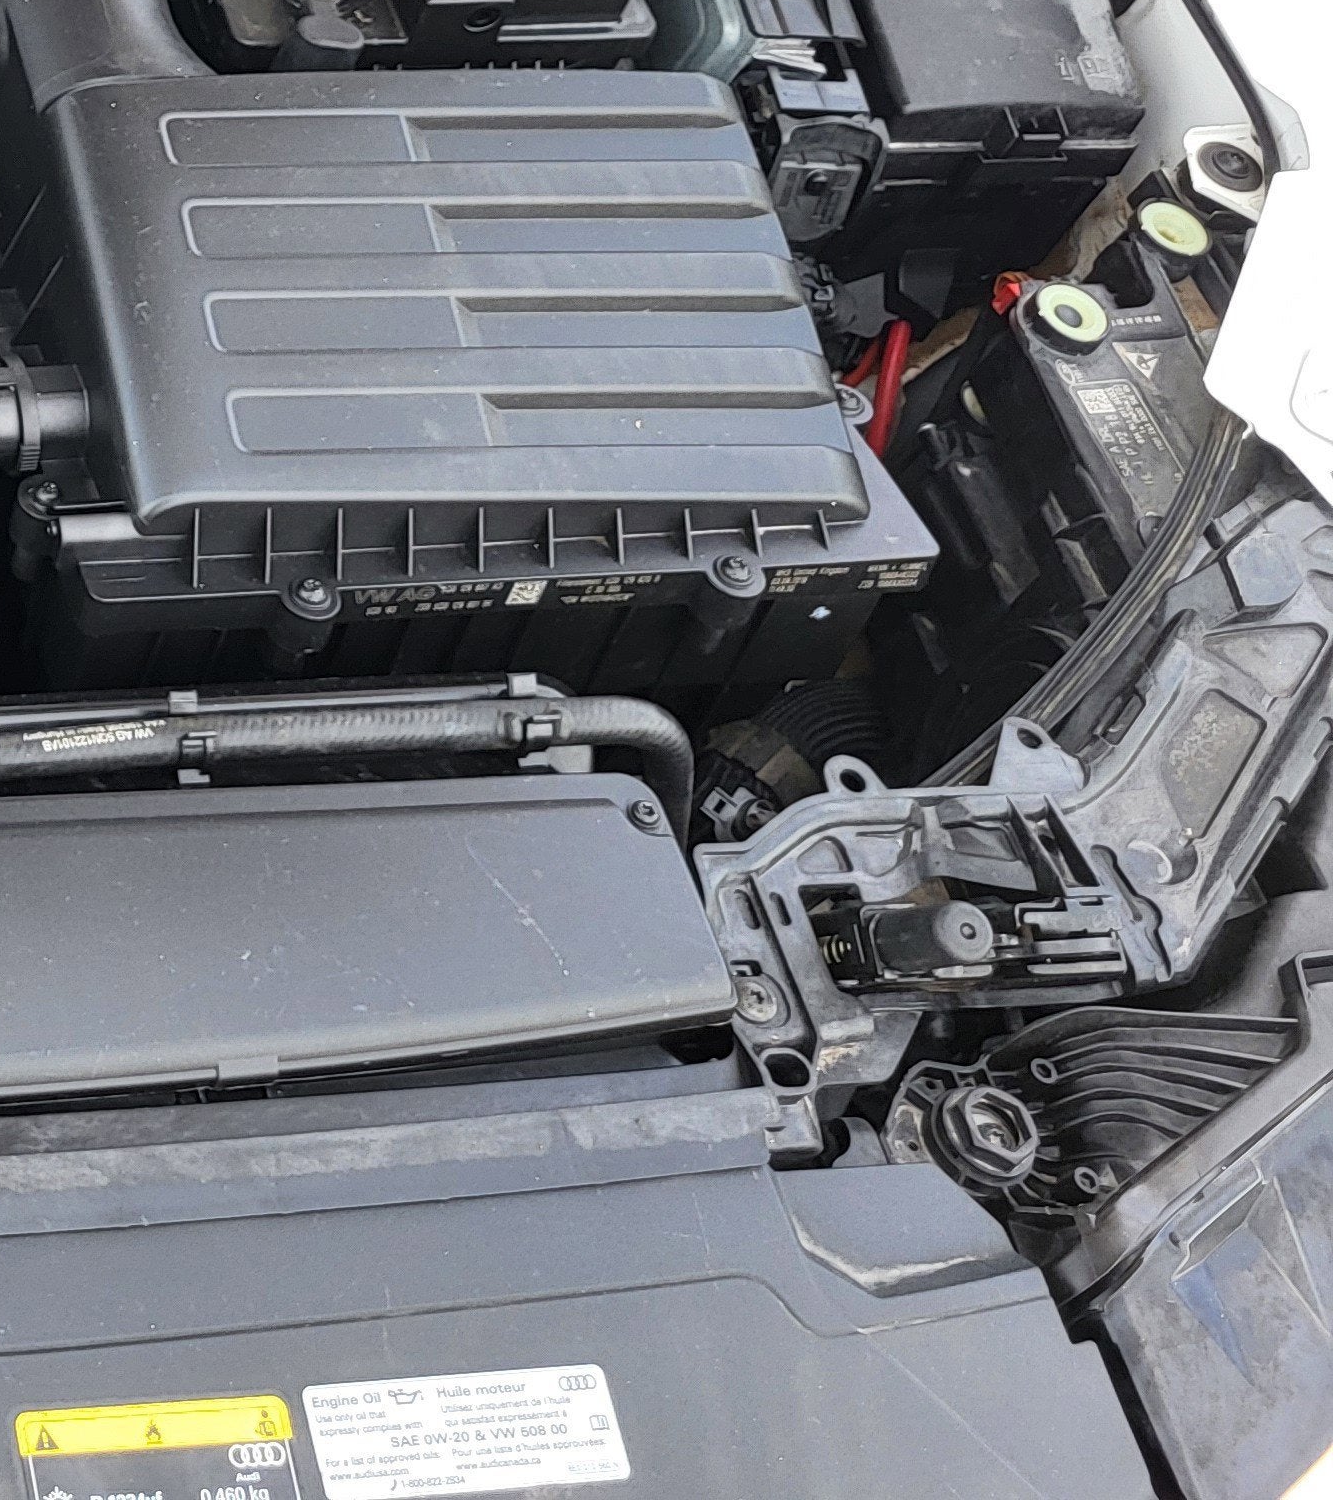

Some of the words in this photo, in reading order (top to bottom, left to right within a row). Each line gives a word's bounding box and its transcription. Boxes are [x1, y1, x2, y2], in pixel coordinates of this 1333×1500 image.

[354, 588, 396, 604] VW
[396, 585, 436, 602] AG
[437, 1385, 471, 1398] Huile
[476, 1383, 526, 1395] moteur
[312, 1396, 359, 1409] Engine
[363, 1392, 381, 1404] Oil
[315, 1414, 332, 1423] Use
[356, 1412, 367, 1420] oil
[369, 1410, 386, 1419] that
[390, 1435, 420, 1448] SAE
[424, 1431, 470, 1445] 0W-20
[475, 1429, 487, 1441] &
[490, 1426, 516, 1440] VW
[520, 1424, 547, 1438] 508
[550, 1423, 568, 1436] 00
[325, 1457, 340, 1468] For
[379, 1452, 420, 1465] approved
[236, 1471, 261, 1482] Audi
